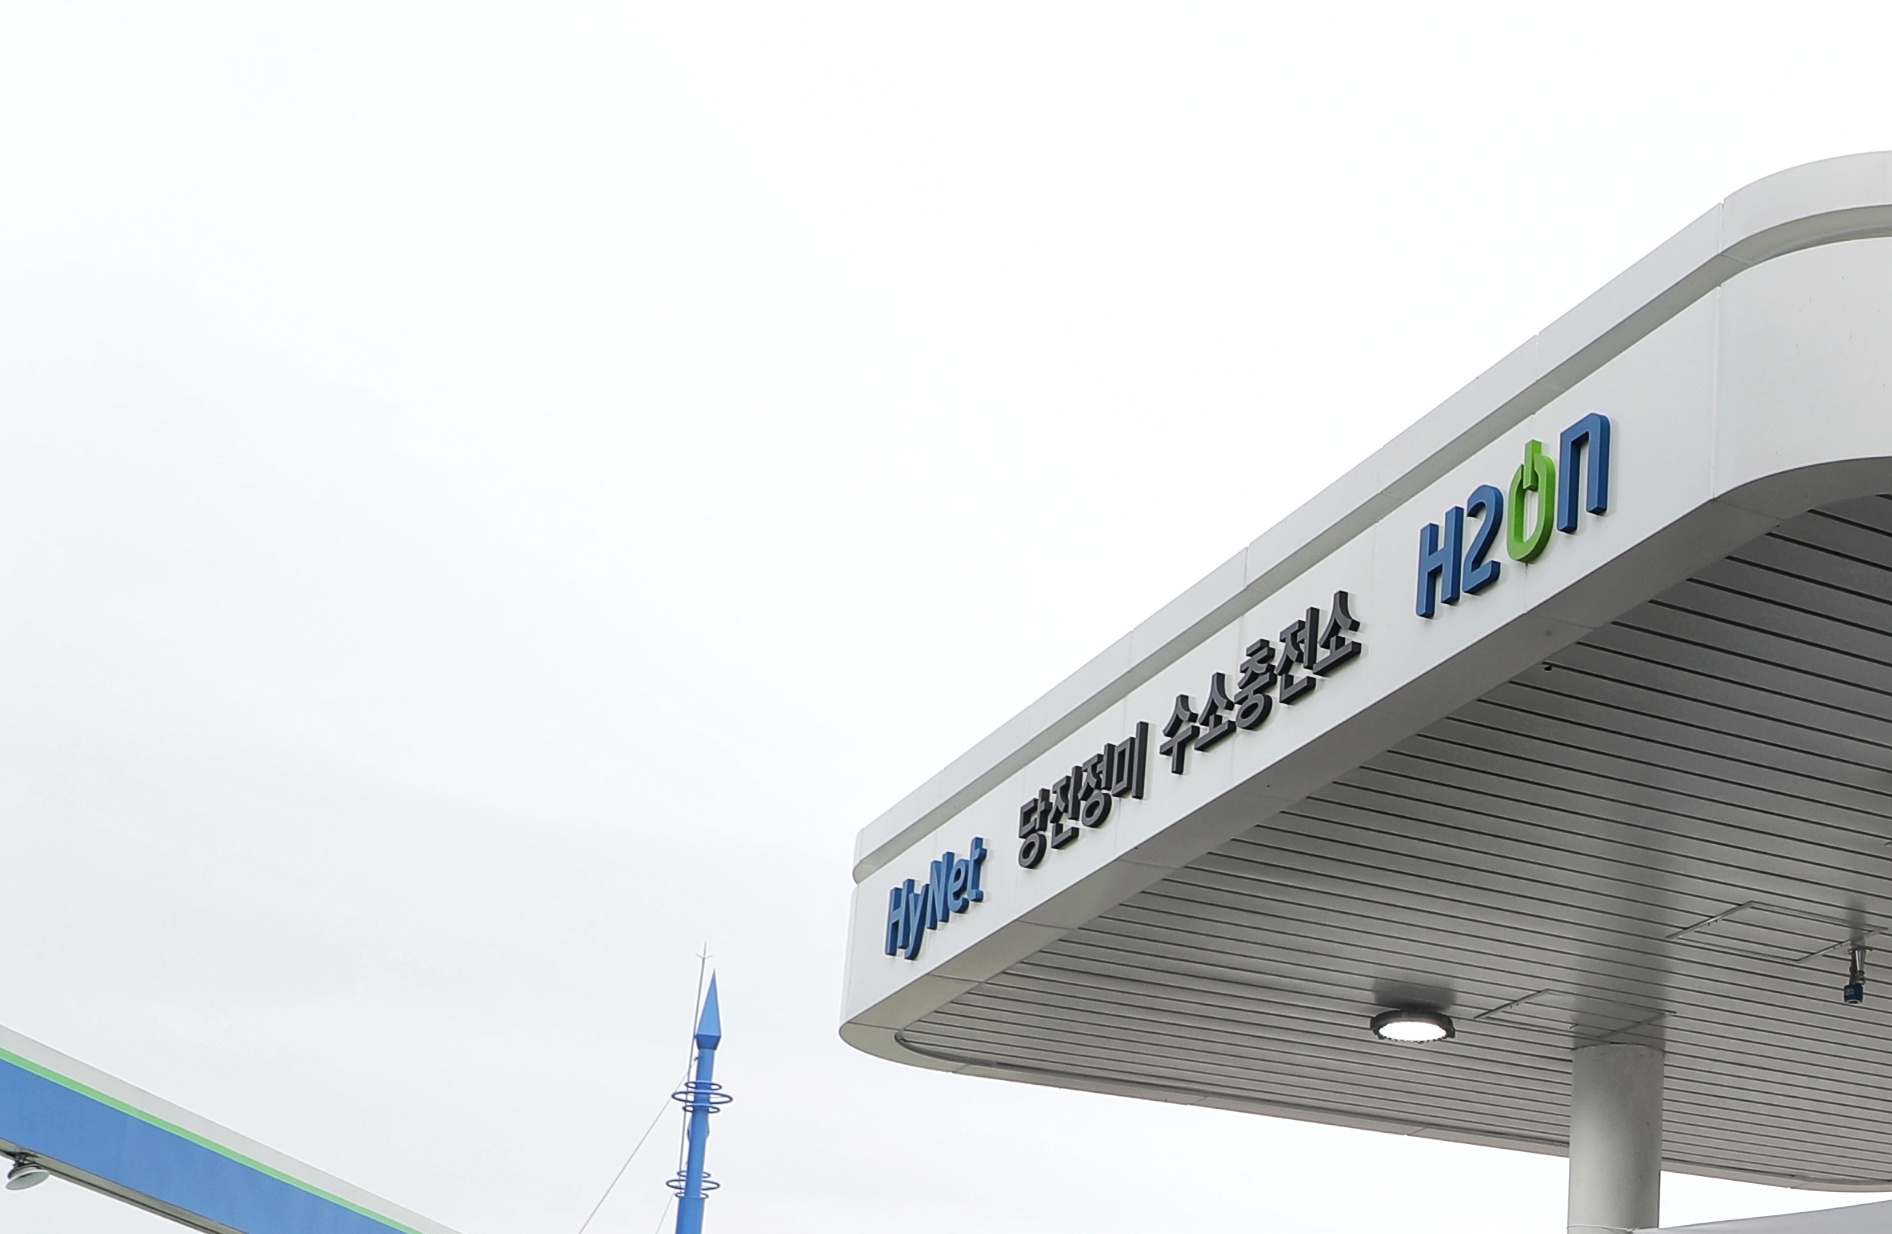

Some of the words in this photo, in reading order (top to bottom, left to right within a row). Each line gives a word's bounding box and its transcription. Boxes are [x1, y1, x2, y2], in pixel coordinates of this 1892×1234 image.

[1017, 721, 1149, 870] 당진정미
[1160, 589, 1362, 774] 수소충전소
[885, 836, 987, 961] HyNet
